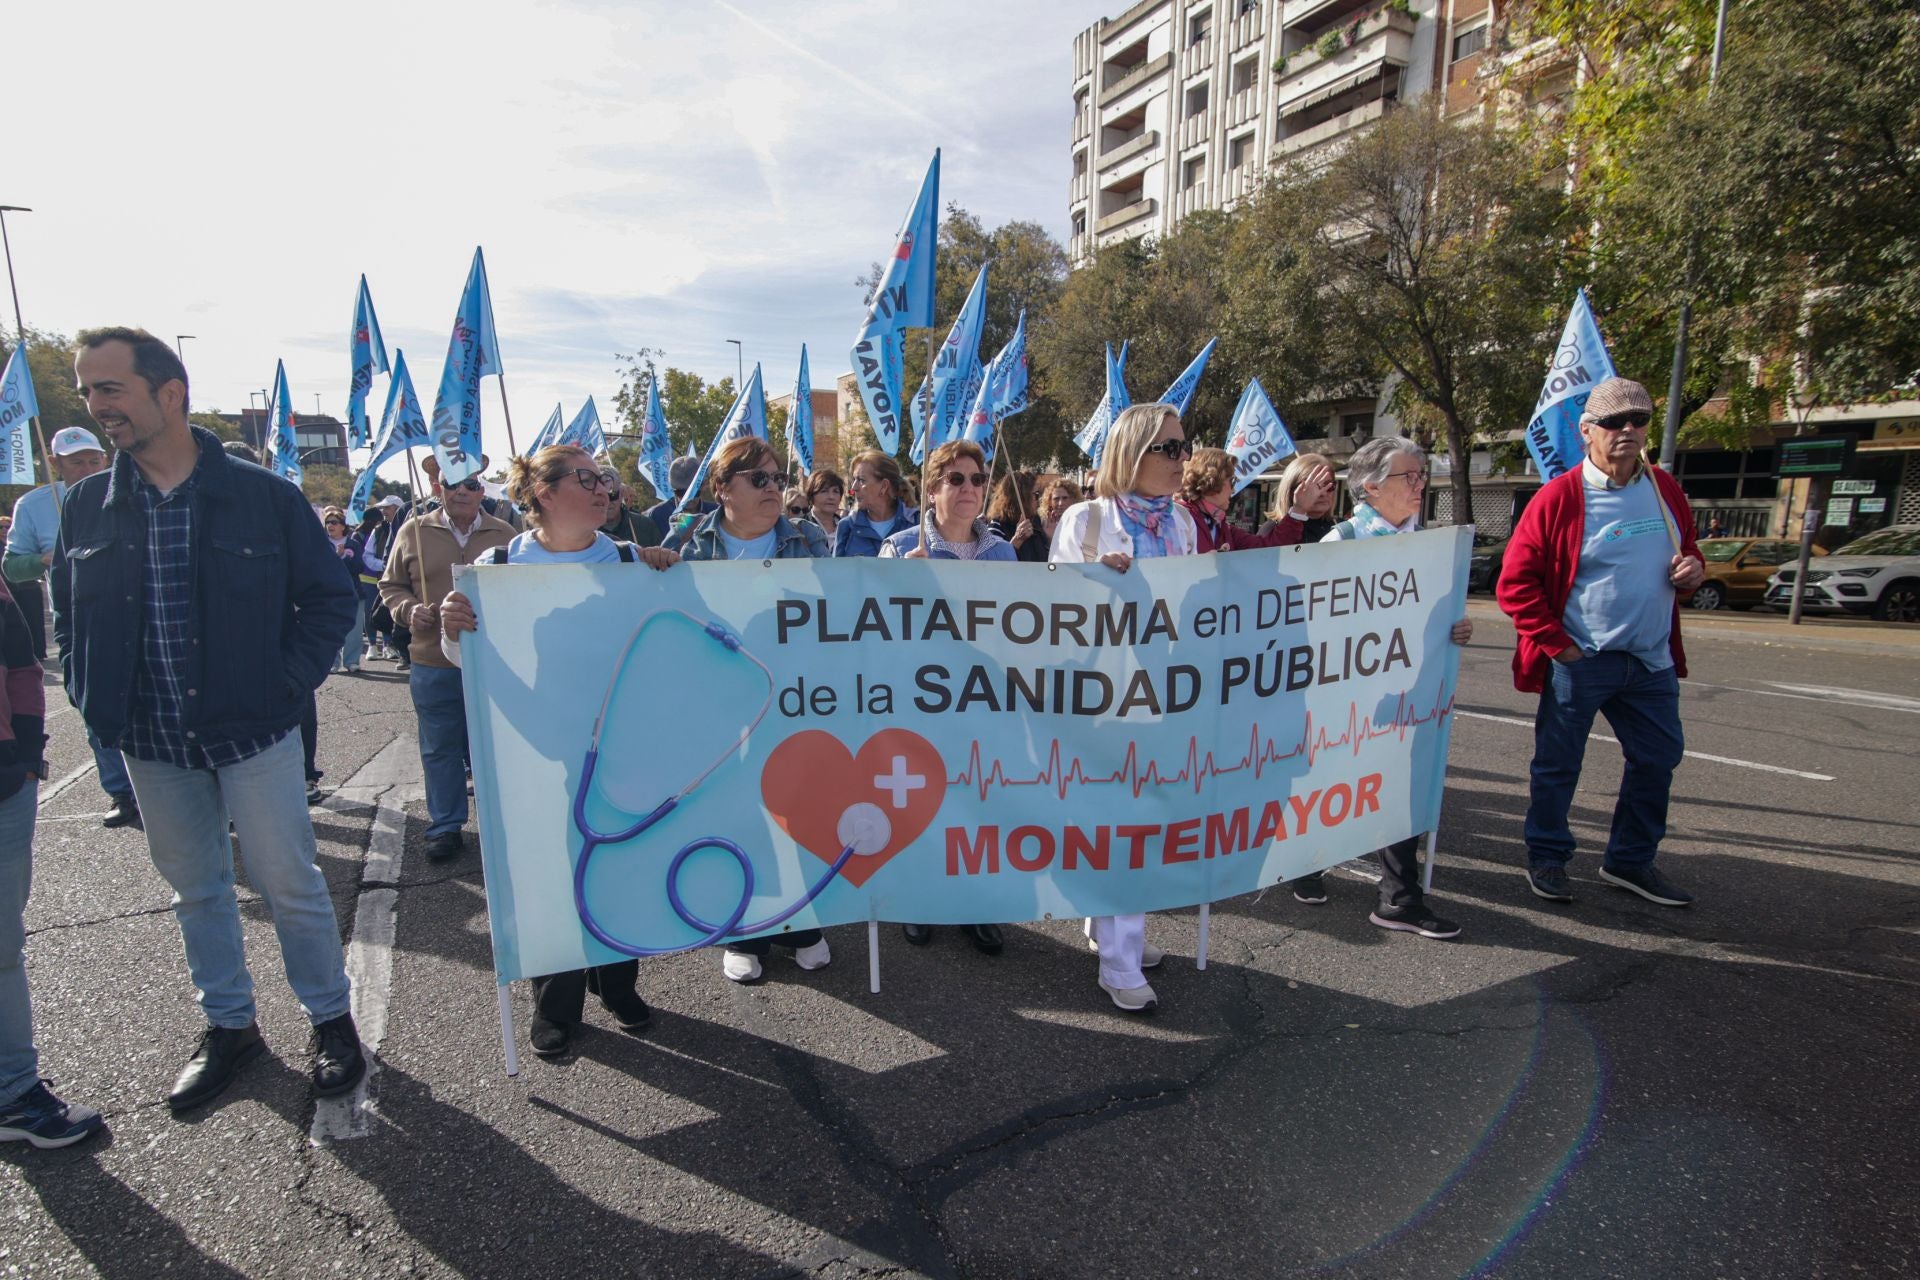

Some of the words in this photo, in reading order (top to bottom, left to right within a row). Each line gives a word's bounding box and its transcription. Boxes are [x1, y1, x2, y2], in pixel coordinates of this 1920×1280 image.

[777, 597, 1178, 647] PLATAFORMA
[1194, 604, 1241, 638] en
[1256, 568, 1420, 630] DEFENSA
[778, 677, 837, 717] de
[856, 674, 894, 714] la
[914, 664, 1202, 718] SANIDAD
[1221, 628, 1411, 705] PÚBLICA
[945, 773, 1382, 876] MONTEMAYOR
